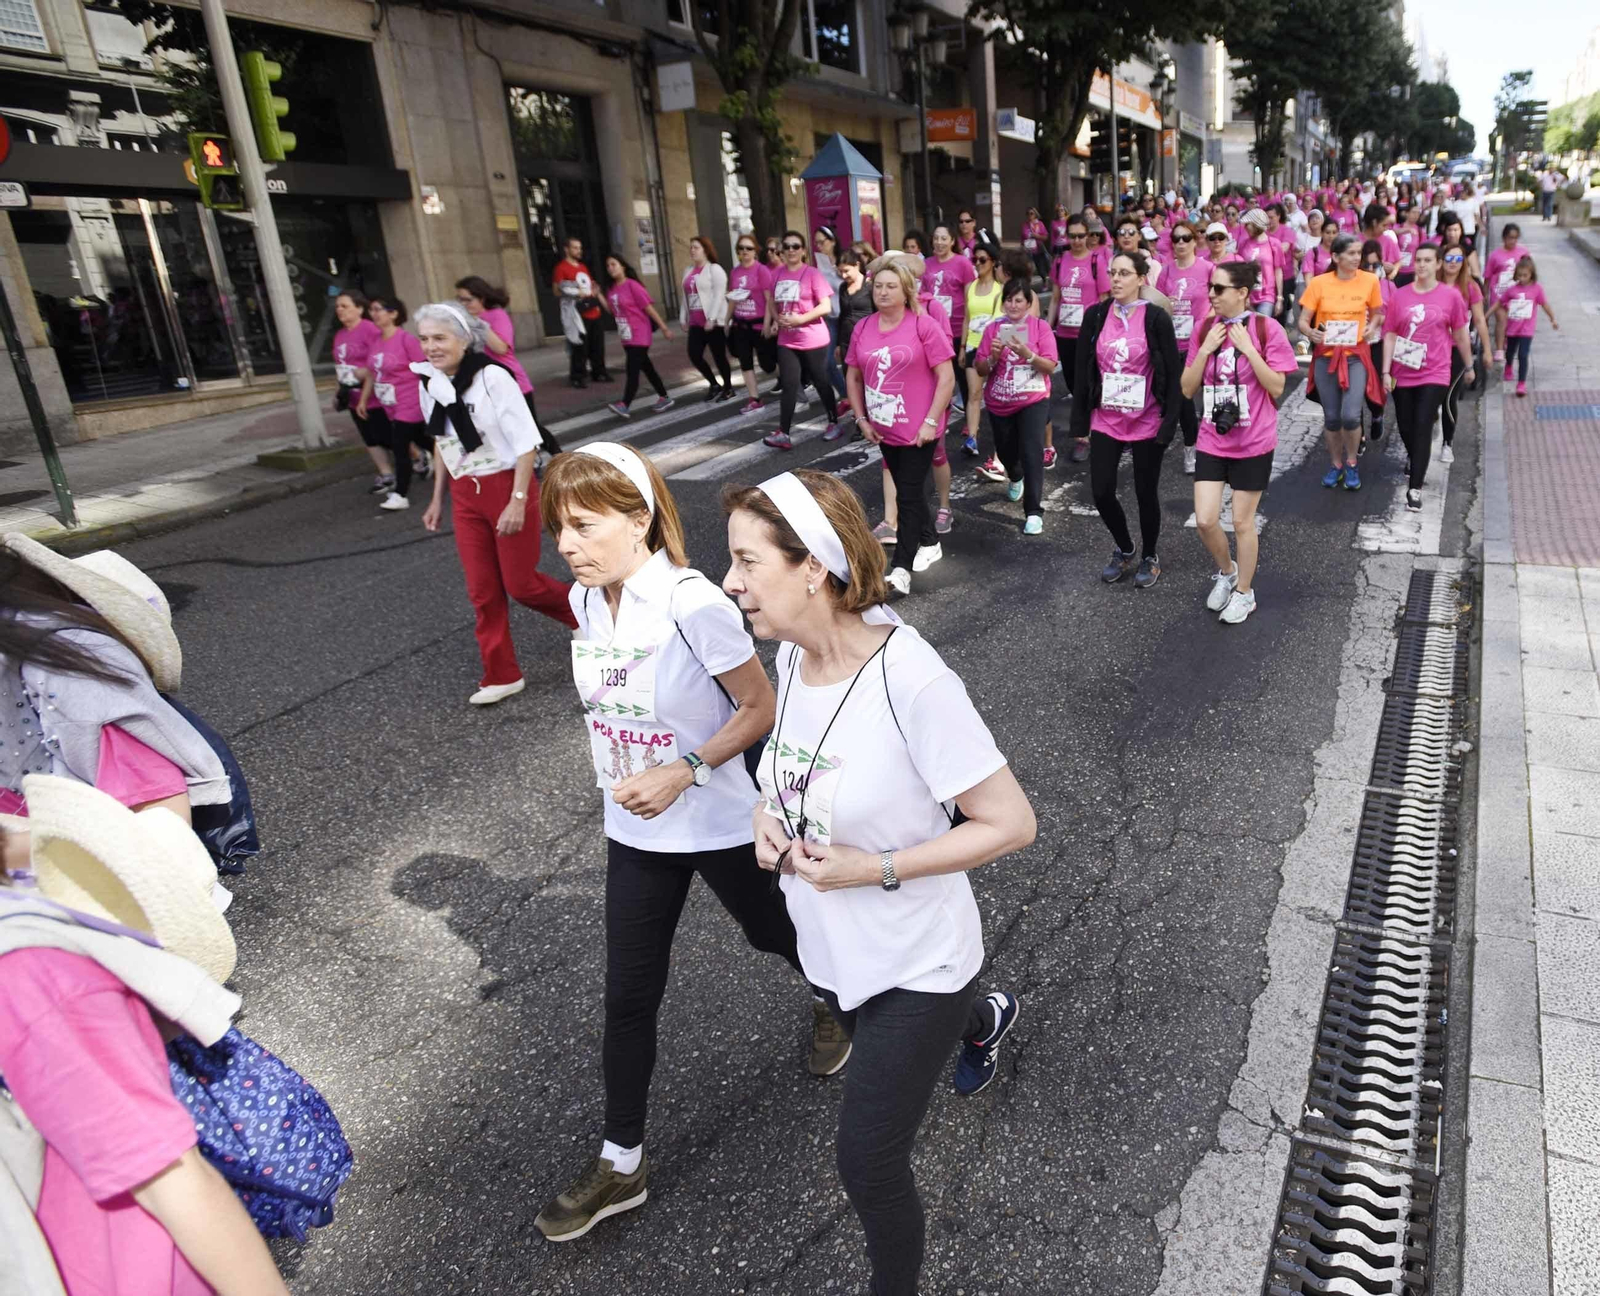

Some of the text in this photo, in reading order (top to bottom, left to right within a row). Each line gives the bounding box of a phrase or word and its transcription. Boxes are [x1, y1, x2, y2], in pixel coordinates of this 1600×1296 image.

[600, 668, 627, 687] 1239
[592, 719, 675, 748] POR ELLAS
[782, 769, 810, 797] 124
